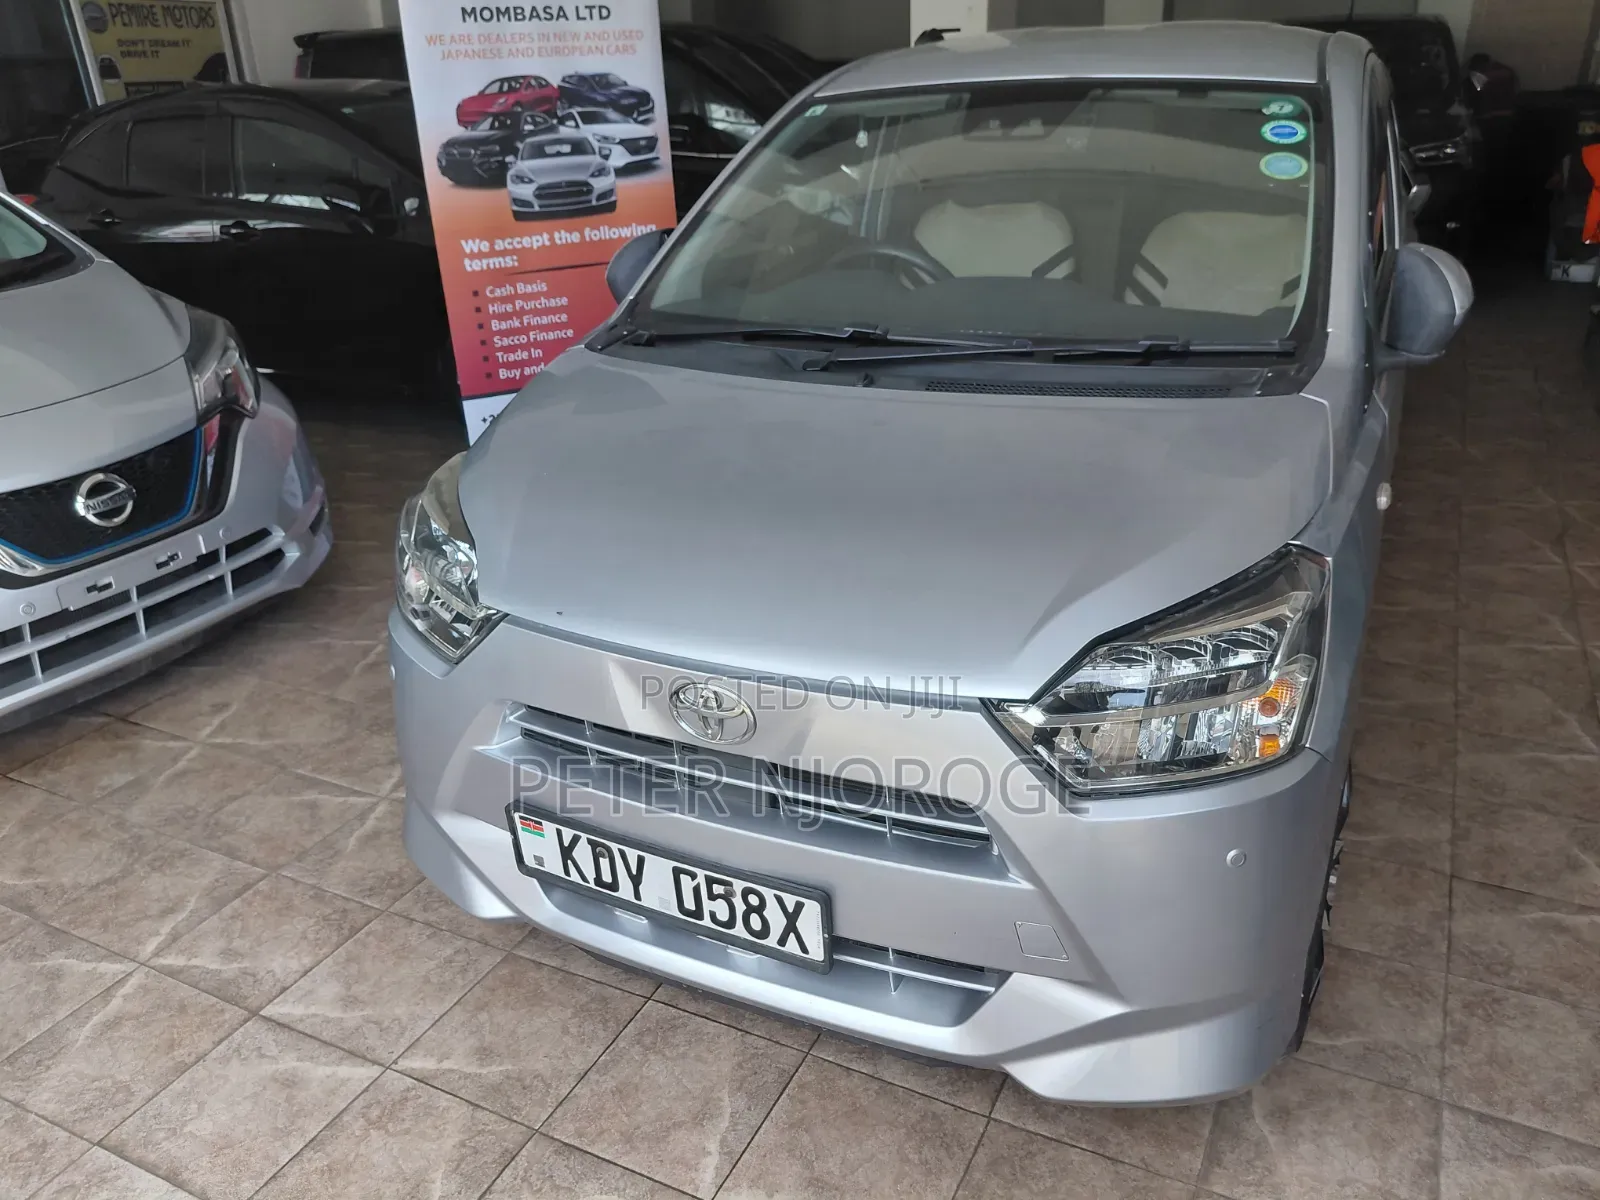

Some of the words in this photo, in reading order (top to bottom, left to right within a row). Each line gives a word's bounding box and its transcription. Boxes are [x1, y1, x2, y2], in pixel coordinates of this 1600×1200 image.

[108, 3, 161, 27] PEMIRE
[162, 4, 215, 29] MOTORS
[461, 5, 569, 23] MOMBASA
[575, 5, 612, 21] LTD
[425, 34, 446, 47] WE
[449, 33, 475, 46] ARE
[478, 32, 534, 45] DEALERS
[537, 31, 552, 43] IN
[553, 31, 582, 43] NEW
[584, 31, 611, 42] AND
[613, 30, 645, 42] USED
[440, 48, 504, 61] JAPANESE
[507, 47, 535, 59] AND
[537, 45, 604, 58] EUROPEAN
[606, 43, 638, 56] CARS
[461, 239, 490, 254] We
[494, 232, 550, 252] accept
[554, 229, 580, 245] the
[463, 255, 519, 272] terms:
[485, 283, 515, 298] Cash
[516, 279, 548, 293] Basis
[488, 302, 513, 315] Hire
[515, 296, 569, 312] Purchase
[490, 317, 521, 332] Bank
[523, 312, 568, 326] Finance
[493, 334, 528, 348] Sacco
[529, 328, 575, 342] Finance
[495, 348, 529, 364] Trade
[530, 347, 543, 359] In
[498, 366, 521, 380] Buy
[555, 827, 647, 902] KDY
[671, 864, 810, 956] 058X
